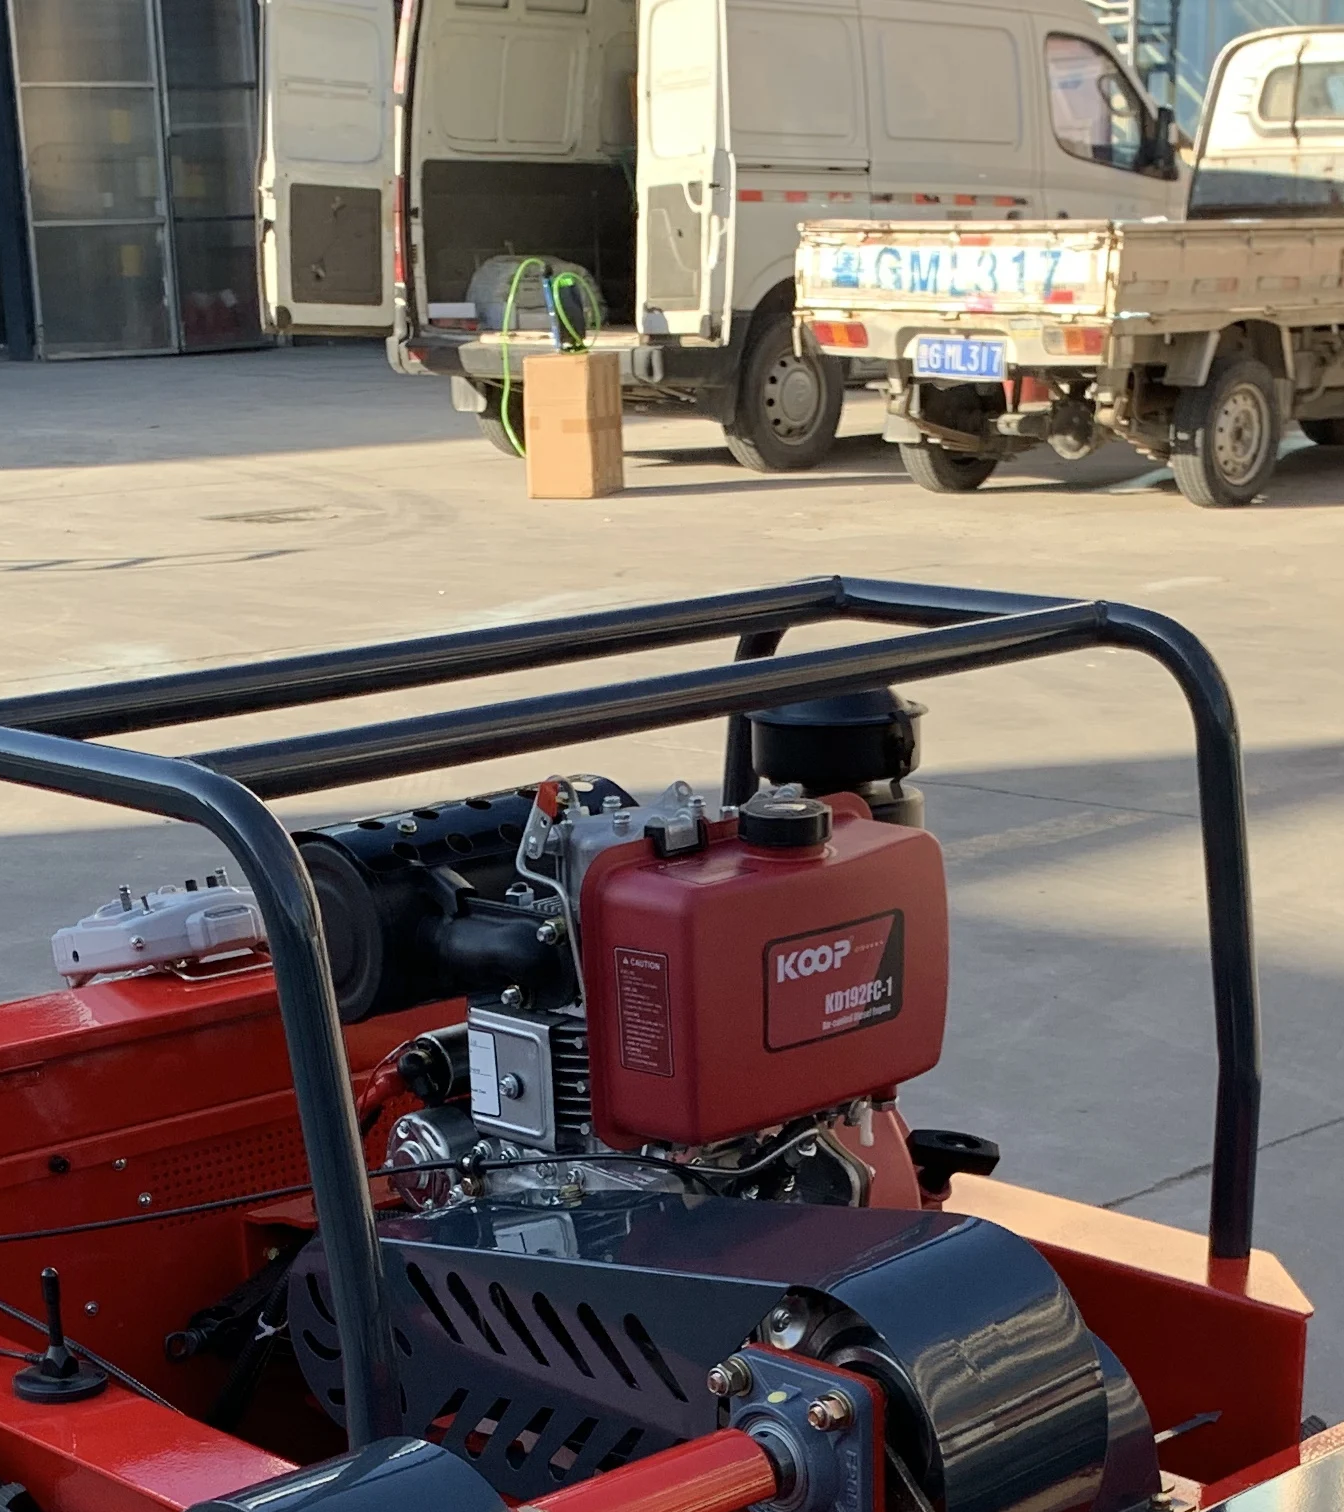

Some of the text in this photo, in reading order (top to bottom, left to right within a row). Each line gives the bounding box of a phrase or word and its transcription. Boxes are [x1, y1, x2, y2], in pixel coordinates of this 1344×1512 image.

[630, 958, 660, 970] CAUTION
[777, 939, 851, 984] KOOP
[824, 976, 893, 1015] KD192FC-1
